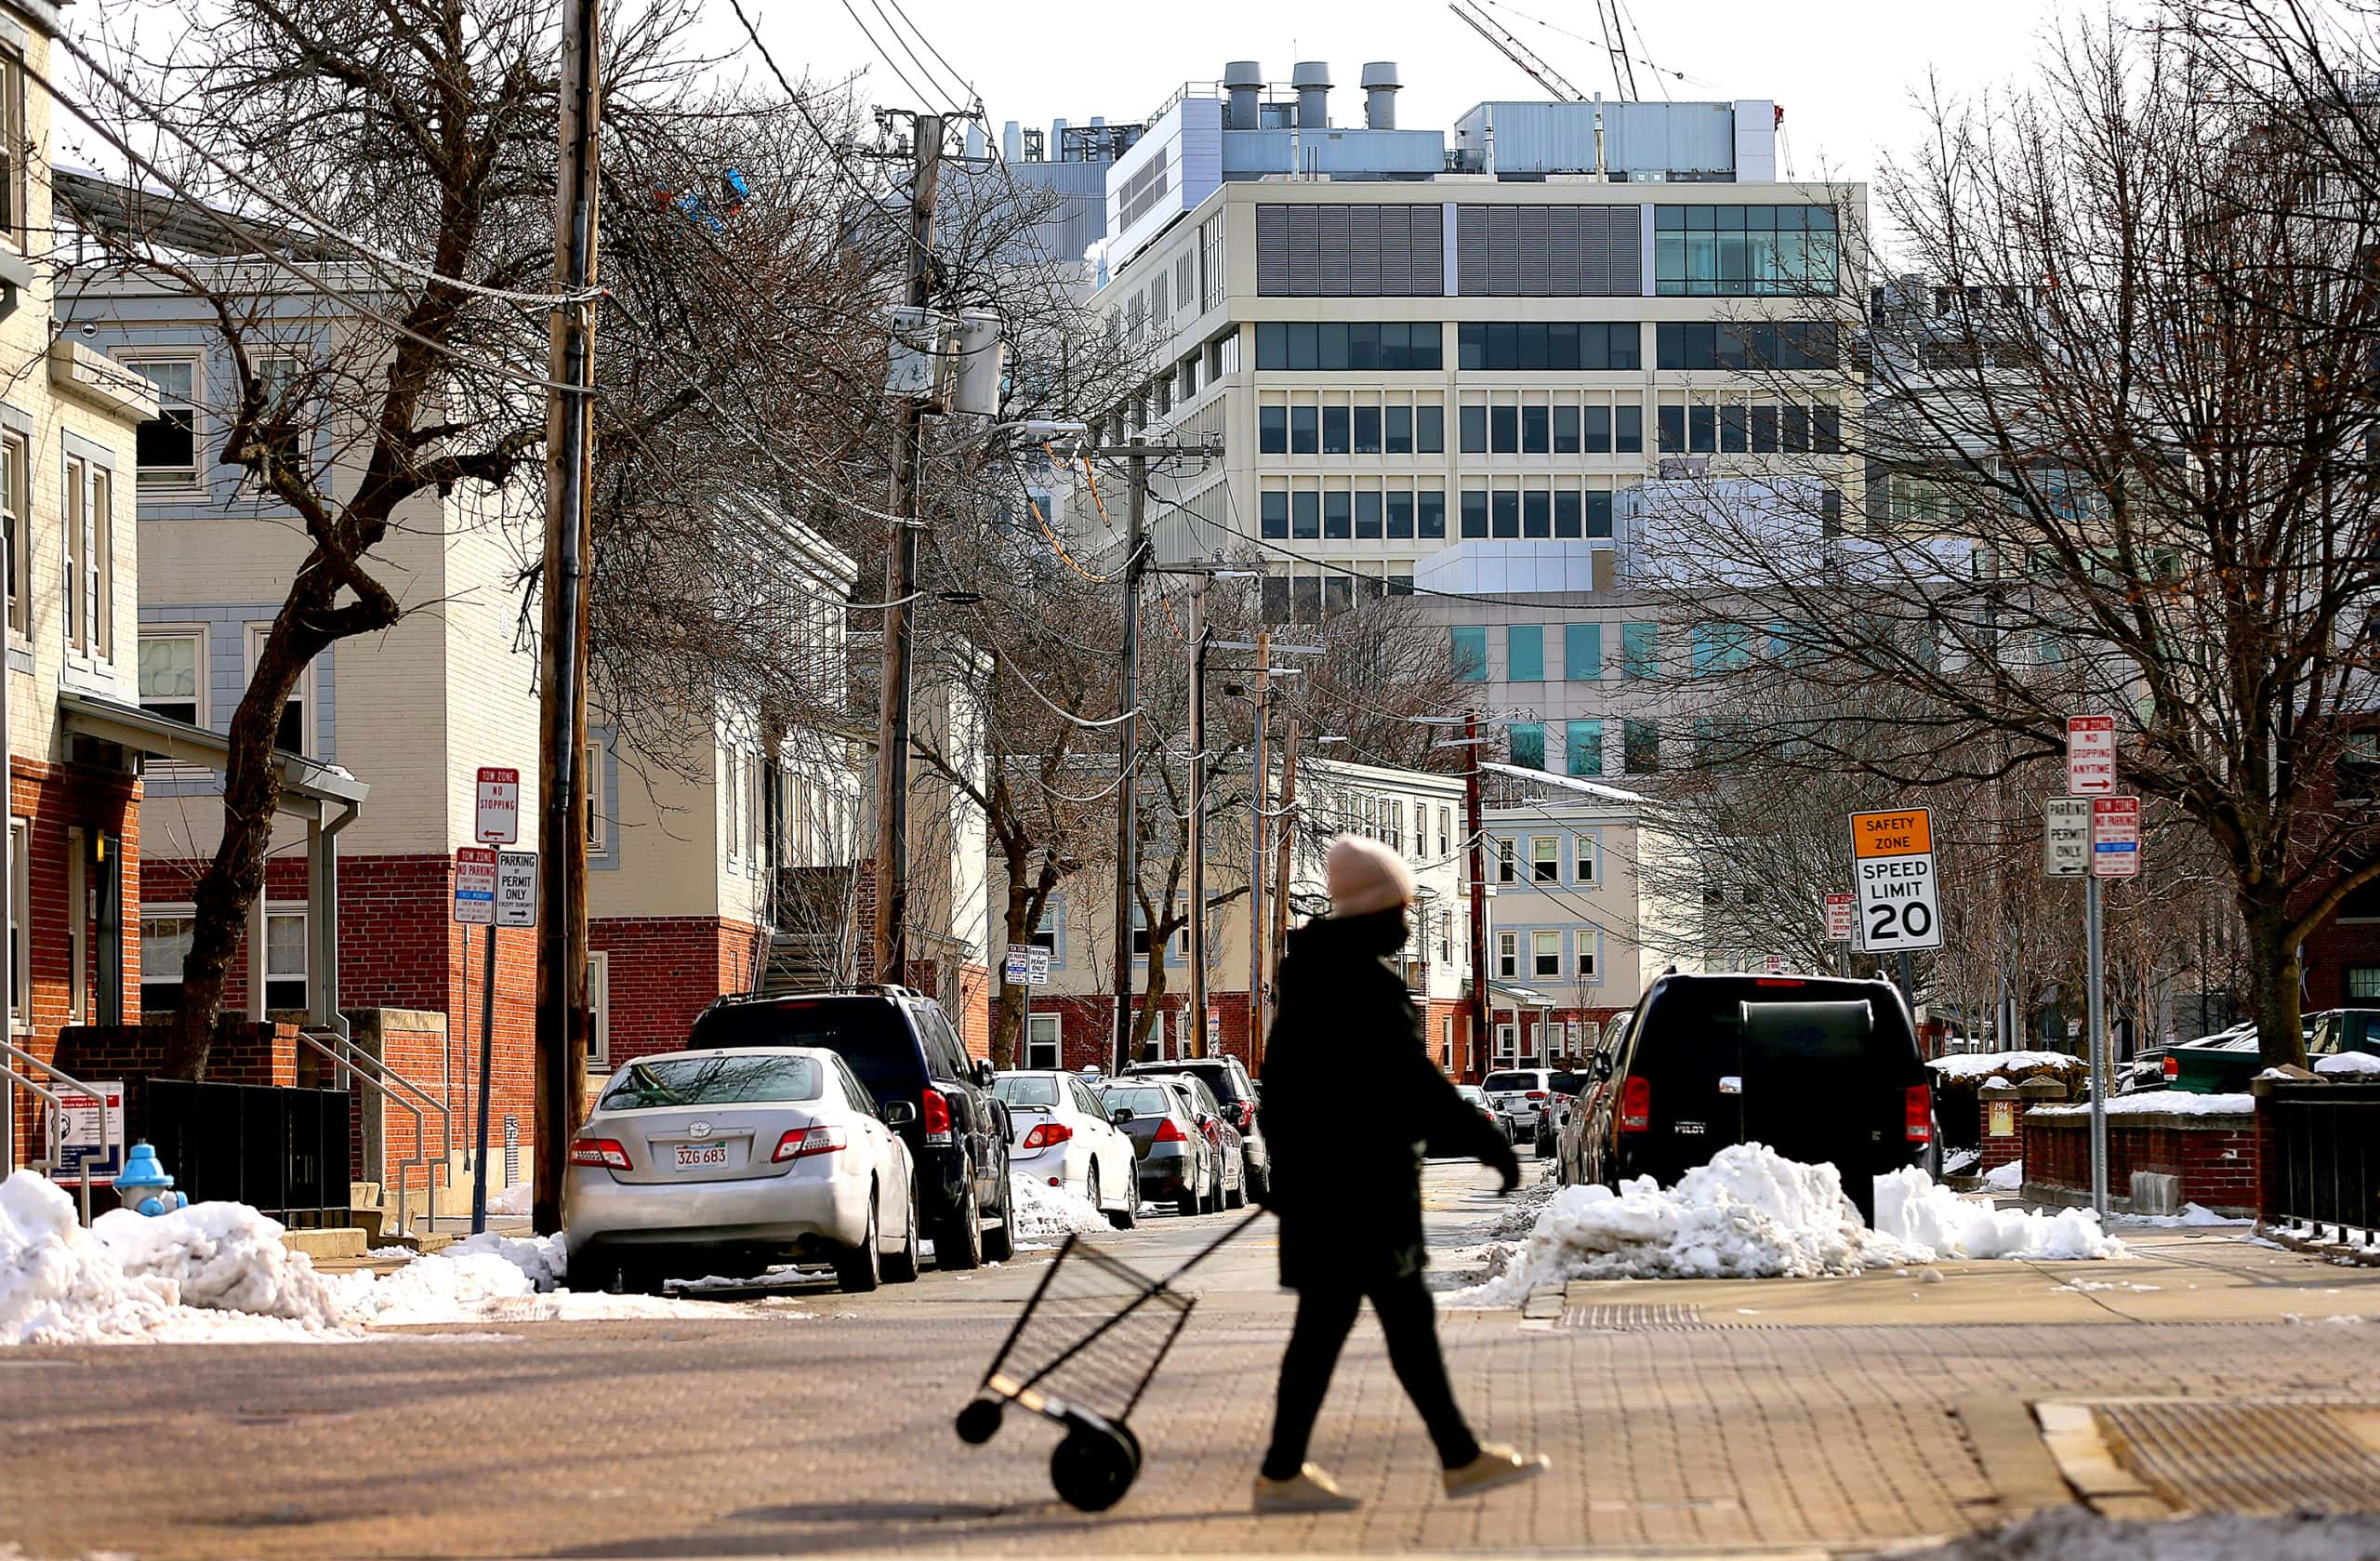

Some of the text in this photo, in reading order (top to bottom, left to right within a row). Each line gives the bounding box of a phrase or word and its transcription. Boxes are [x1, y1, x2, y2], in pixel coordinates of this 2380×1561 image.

[2071, 720, 2111, 730] TOW ZONE
[2085, 734, 2098, 743] NO
[2073, 749, 2110, 758] STOPPING
[2073, 764, 2110, 774] ANYTIME
[482, 771, 514, 782] TOW ZONE
[492, 786, 503, 796] NO
[480, 799, 515, 810] STOPPING
[2050, 802, 2086, 816] PARKING
[2097, 799, 2134, 812] TOW ZONE
[1866, 818, 1914, 831] SAFETY
[2051, 828, 2087, 841] PERMIT
[1876, 836, 1910, 849] ZONE
[462, 850, 491, 862] TOW ZONE
[2056, 845, 2081, 857] ONLY
[500, 855, 535, 867] PARKING
[459, 864, 494, 877] NO PARKING
[1864, 861, 1927, 879] SPEED
[502, 876, 531, 887] PERMIT
[506, 889, 527, 900] ONLY
[1871, 882, 1922, 899] LIMIT
[1868, 901, 1931, 940] 20
[678, 1149, 725, 1164] 3ZG 683
